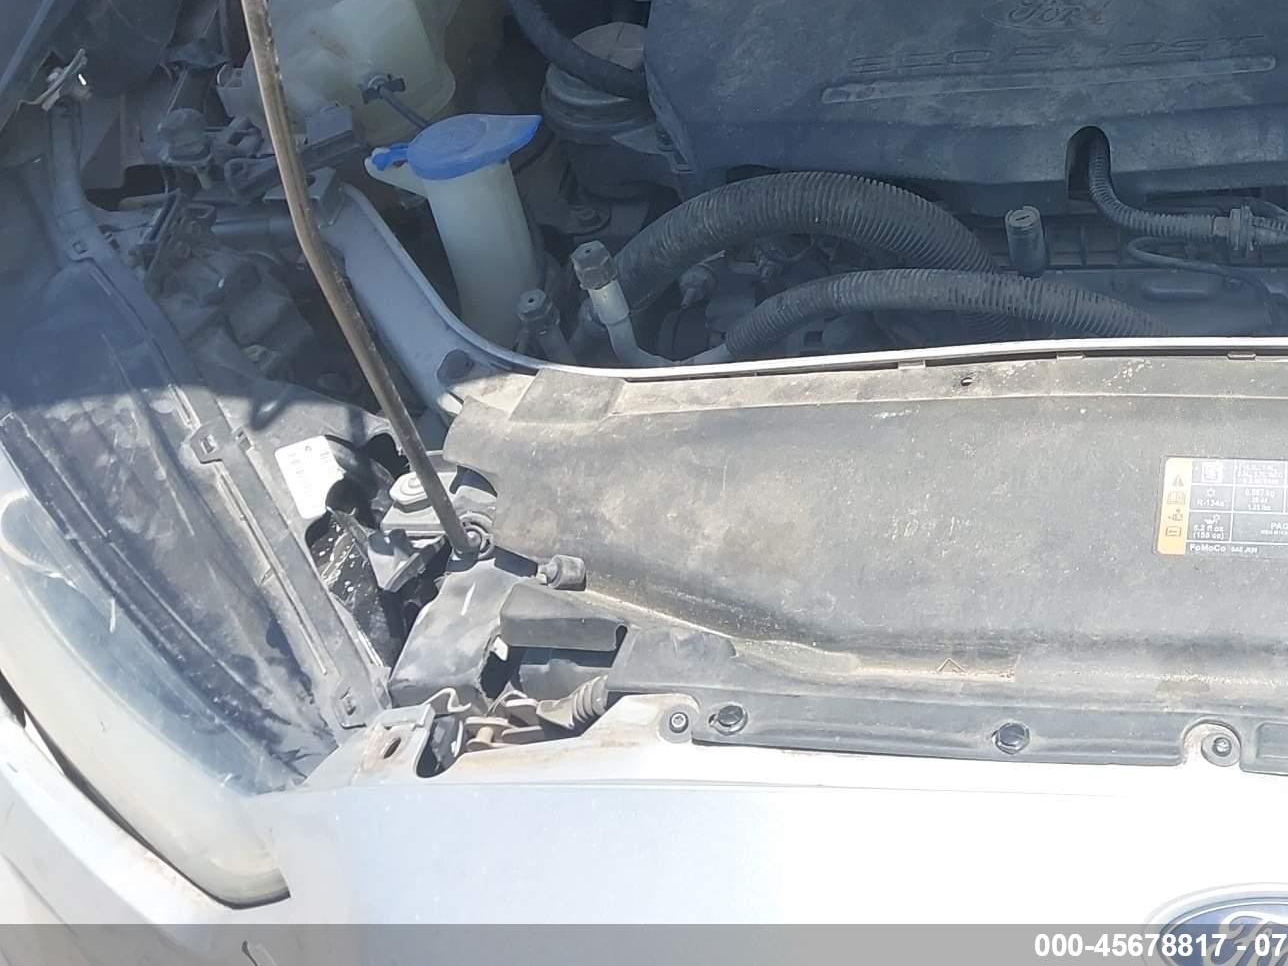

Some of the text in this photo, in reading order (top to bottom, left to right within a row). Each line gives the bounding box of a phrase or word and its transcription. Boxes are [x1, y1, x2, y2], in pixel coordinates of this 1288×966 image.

[1196, 498, 1225, 508] R-134a
[1270, 522, 1288, 531] PAG
[1189, 542, 1227, 553] FoMoCo
